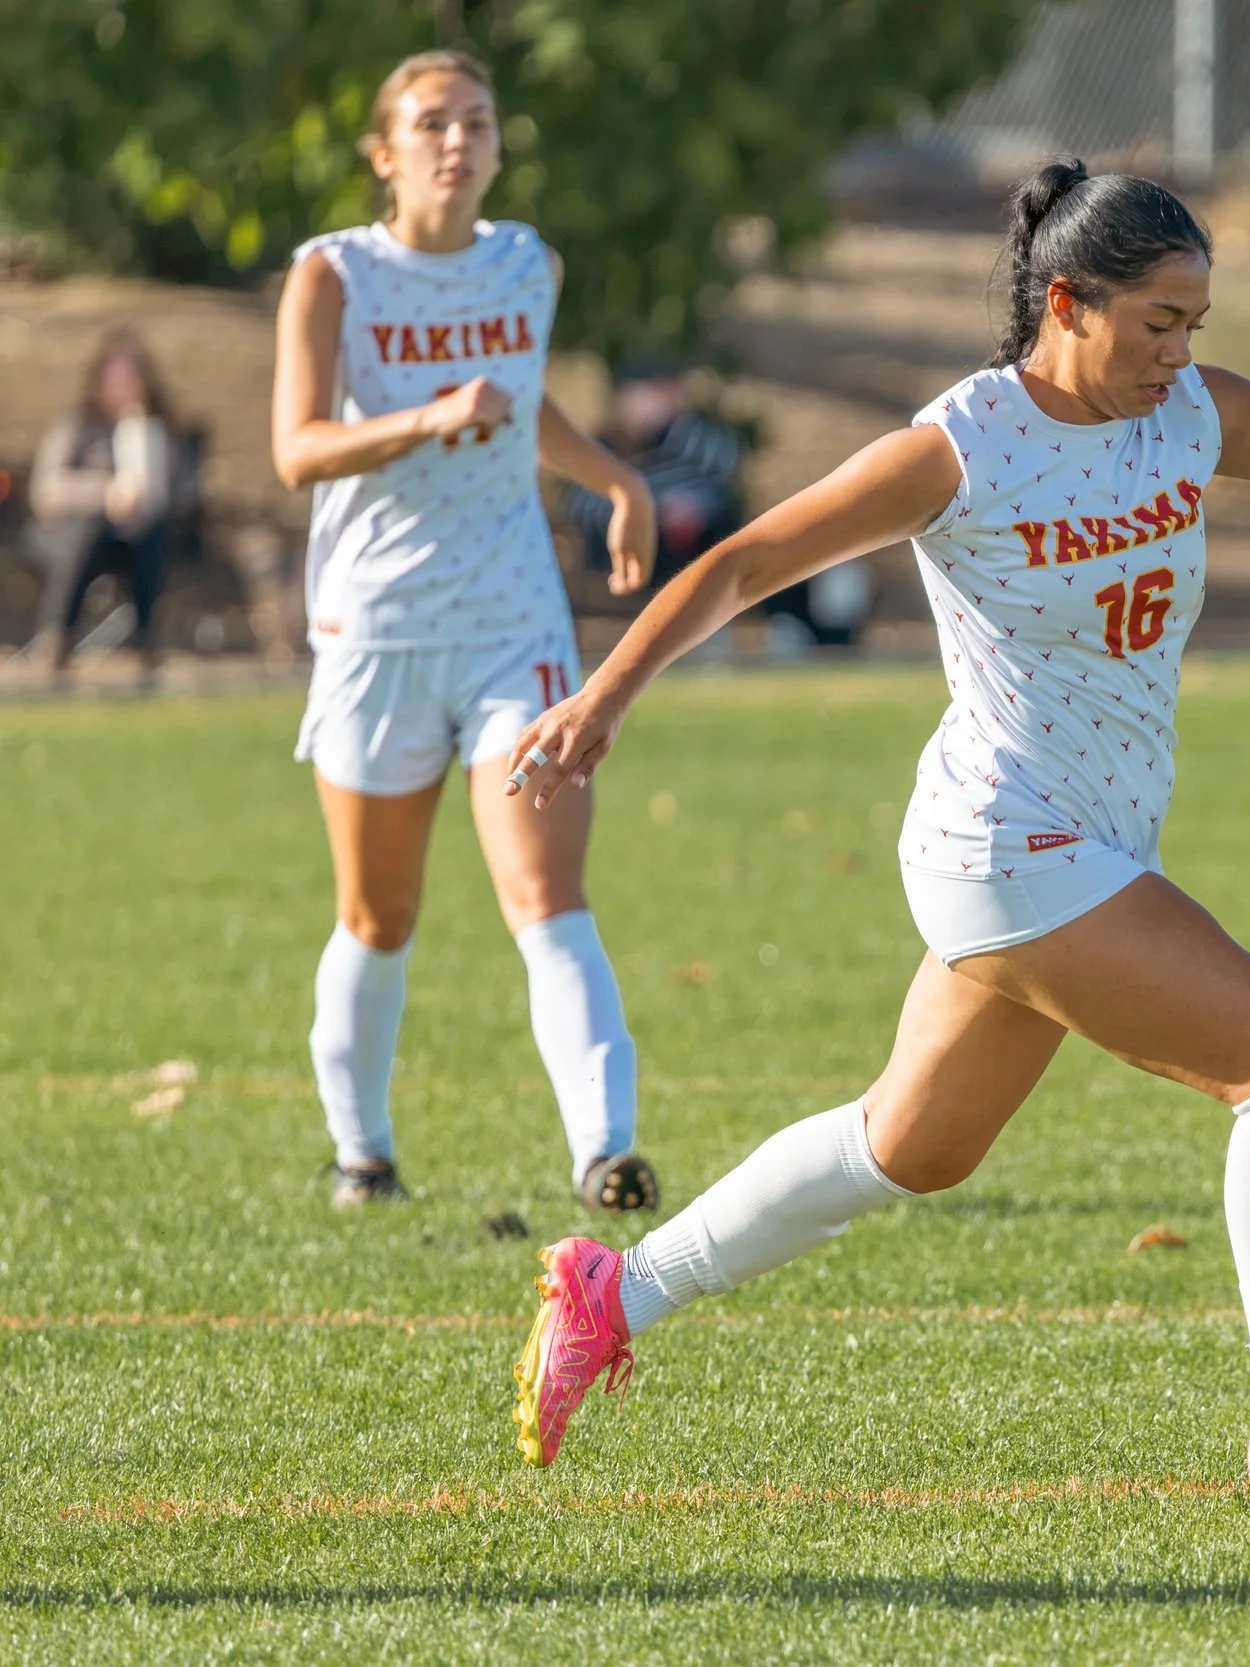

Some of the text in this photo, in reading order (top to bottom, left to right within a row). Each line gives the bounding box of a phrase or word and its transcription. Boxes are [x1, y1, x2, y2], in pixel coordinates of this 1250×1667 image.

[370, 311, 534, 364] YAKIMA
[1011, 476, 1202, 569] YAKIMA
[1094, 566, 1176, 661] 16
